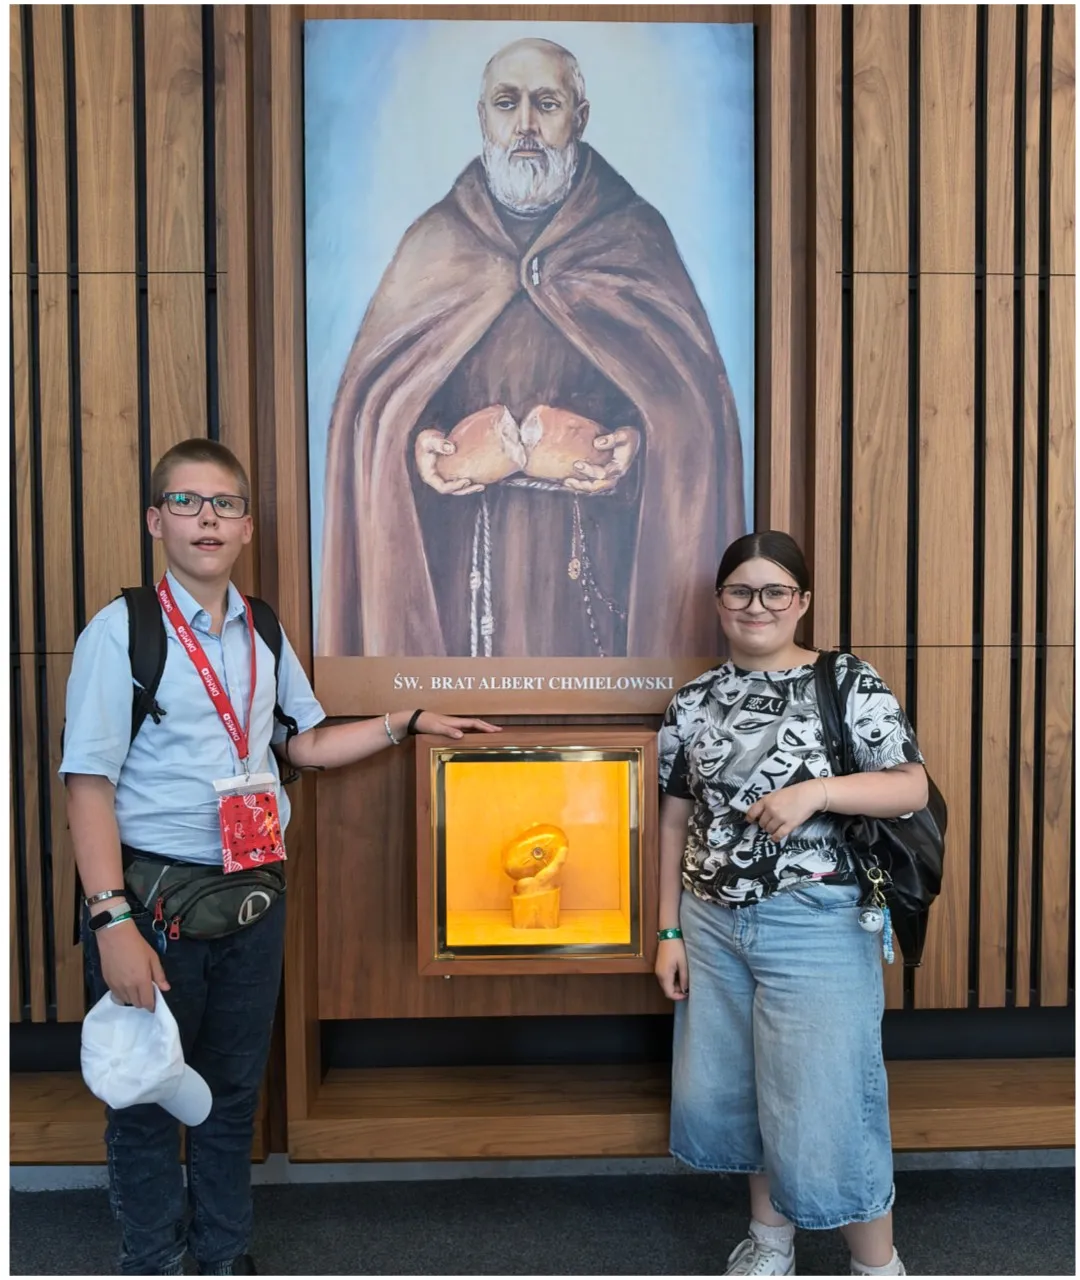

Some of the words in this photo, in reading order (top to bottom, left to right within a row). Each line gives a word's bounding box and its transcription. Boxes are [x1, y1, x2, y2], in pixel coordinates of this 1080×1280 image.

[394, 673, 423, 690] ŚW.
[431, 676, 475, 690] BRAT
[479, 676, 545, 690] ALBERT
[549, 676, 674, 690] CHMIELOWSKI
